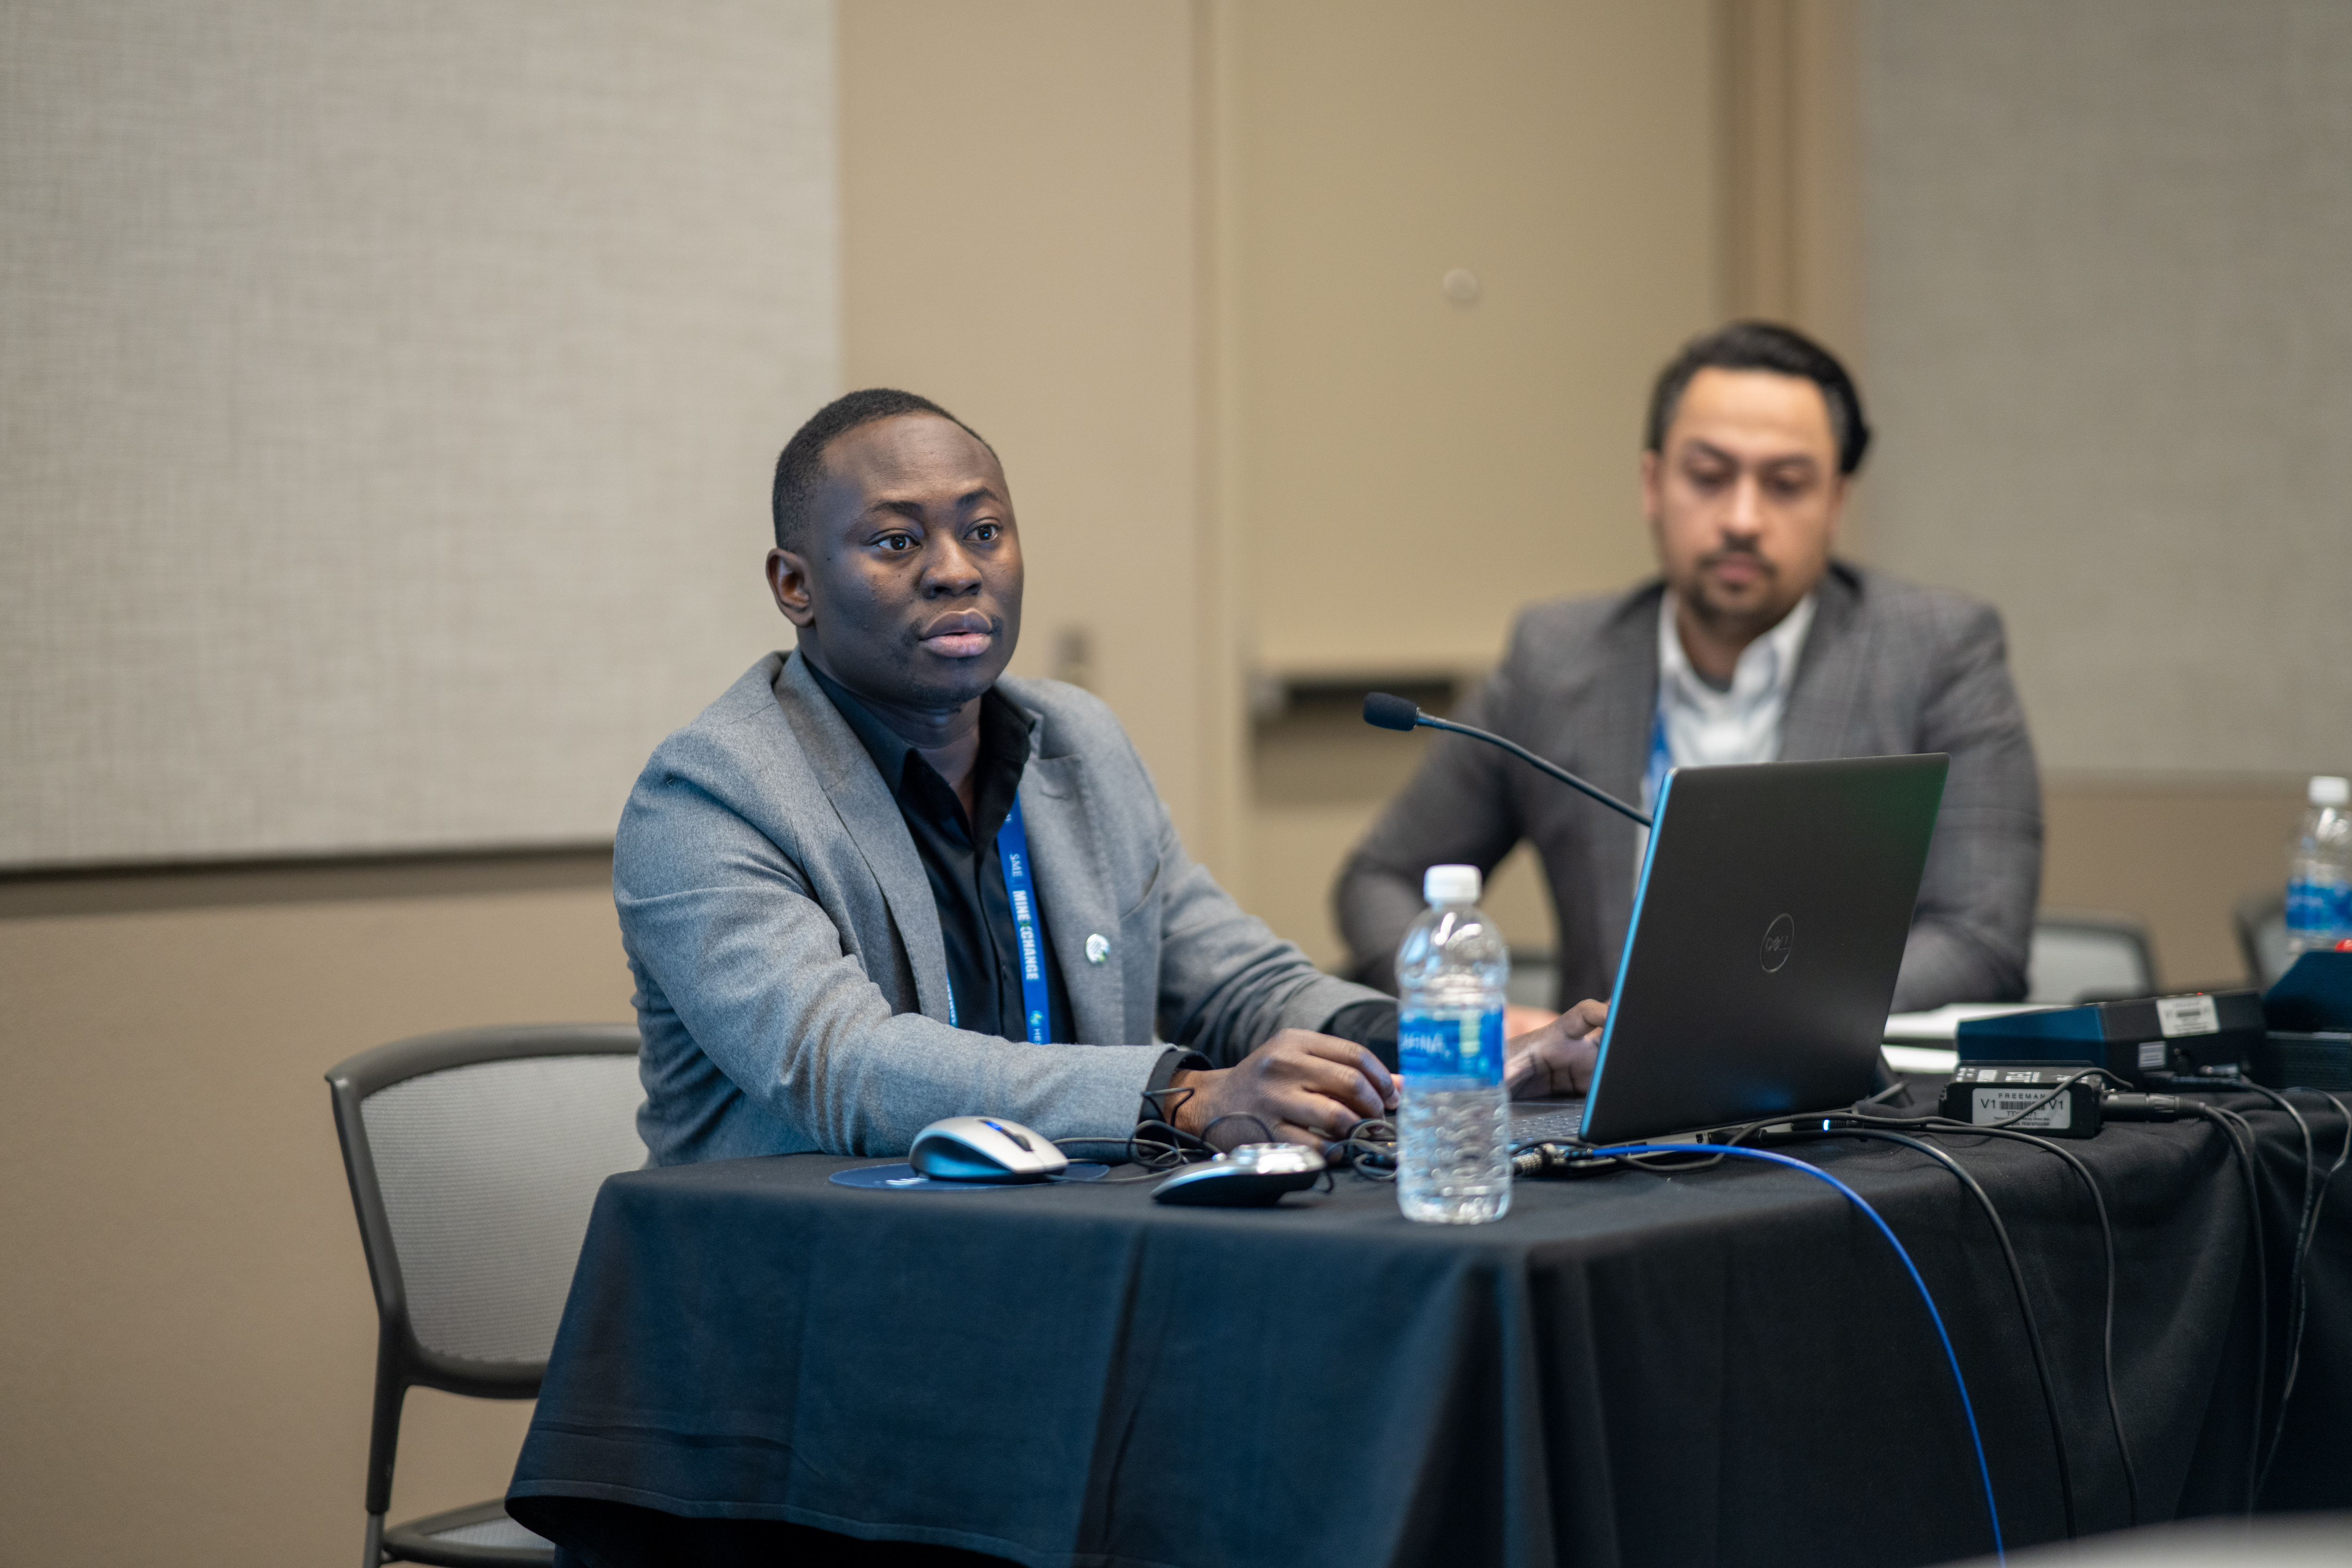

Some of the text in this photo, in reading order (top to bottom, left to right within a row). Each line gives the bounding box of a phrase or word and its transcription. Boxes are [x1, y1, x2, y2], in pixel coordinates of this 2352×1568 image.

[1009, 853, 1023, 877] SME
[1981, 1098, 1995, 1108] V1
[2049, 1099, 2063, 1109] V1
